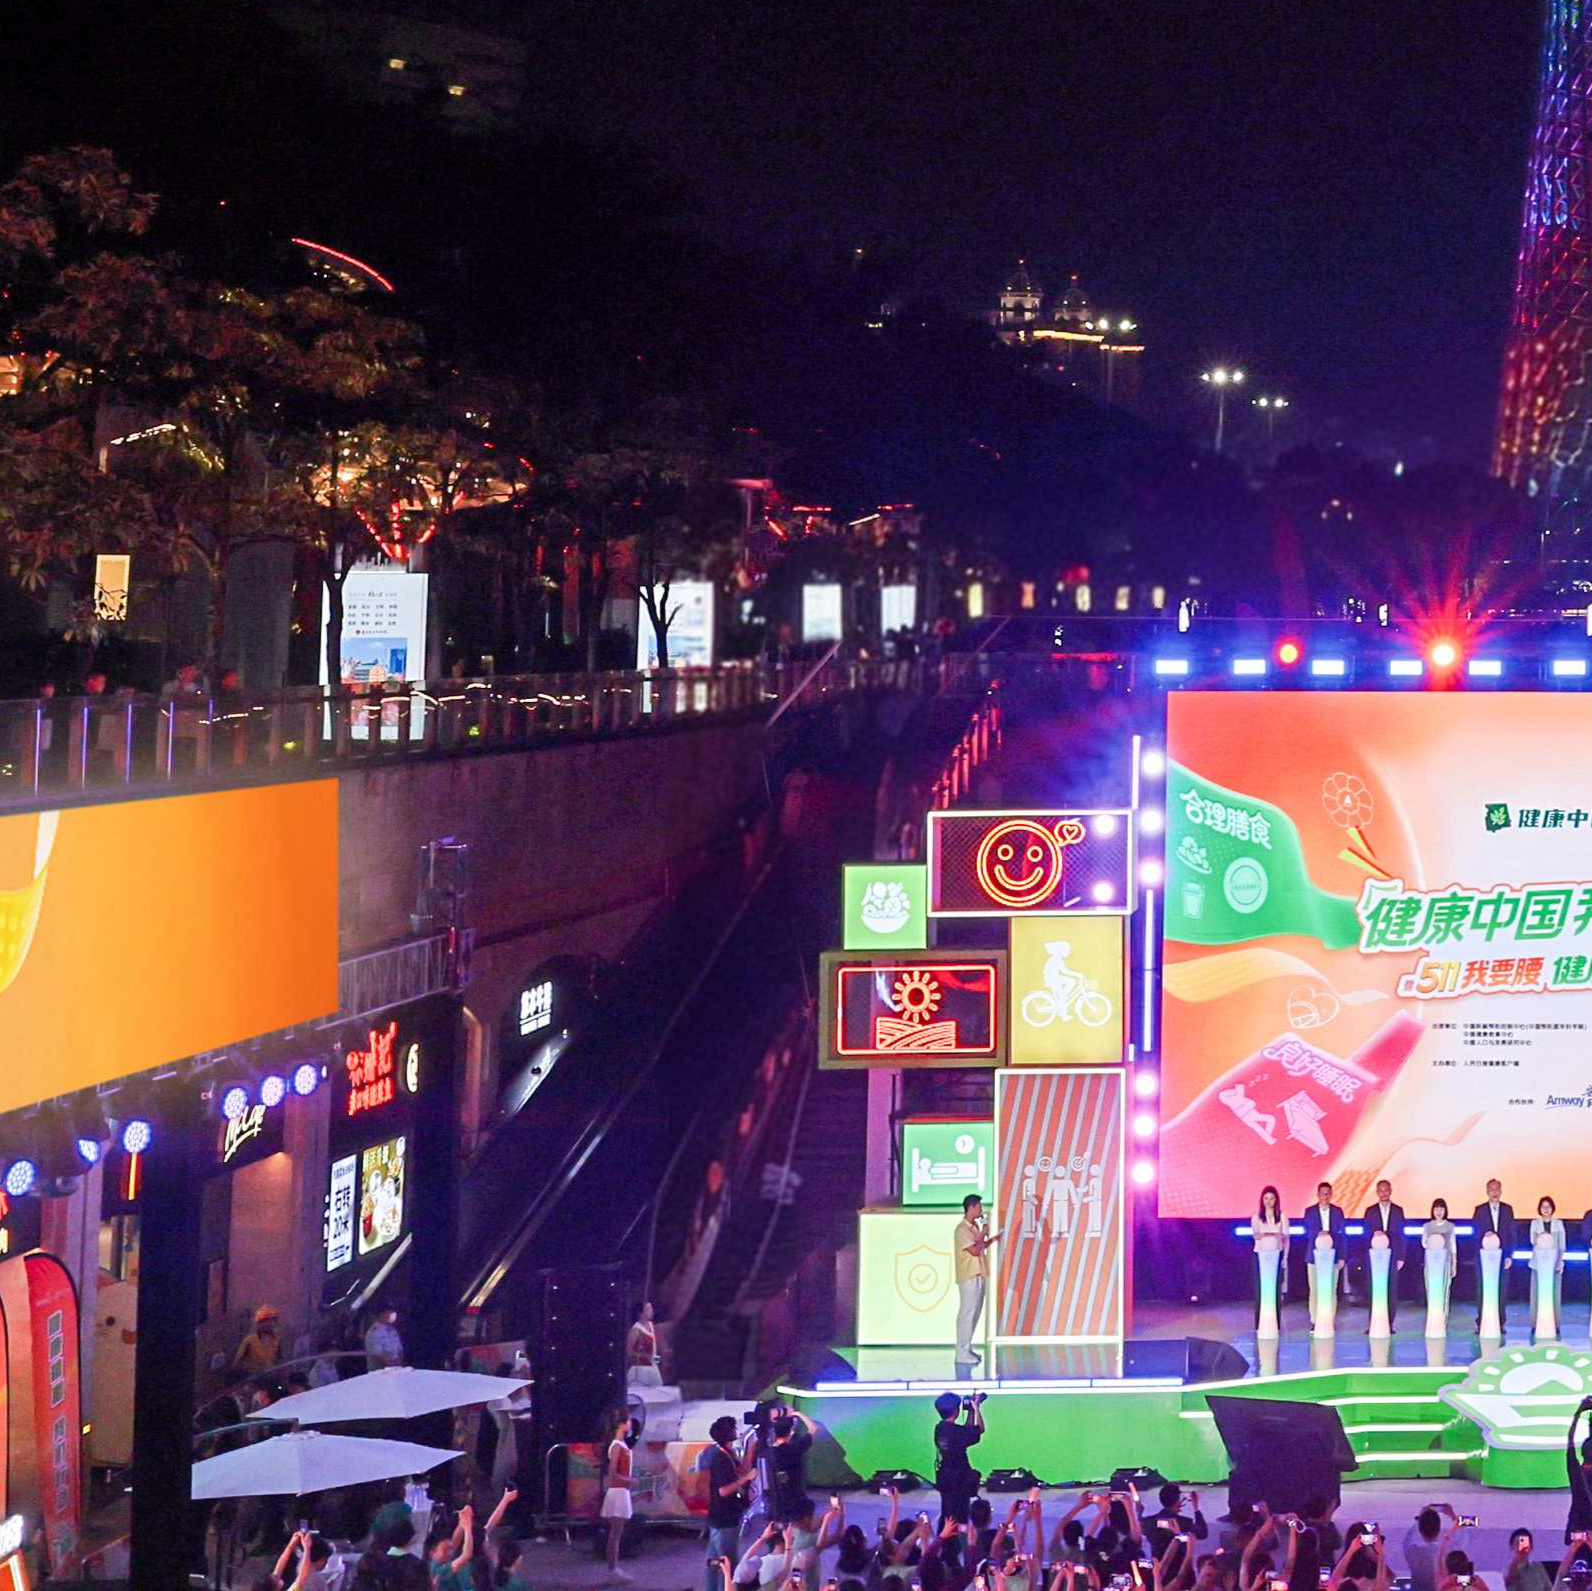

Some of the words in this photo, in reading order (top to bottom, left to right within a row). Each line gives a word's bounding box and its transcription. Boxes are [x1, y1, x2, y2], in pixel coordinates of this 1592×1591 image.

[1179, 788, 1273, 850] 合理膳食
[1262, 1040, 1362, 1103] 良好睡眠
[1546, 1094, 1584, 1107] Amway
